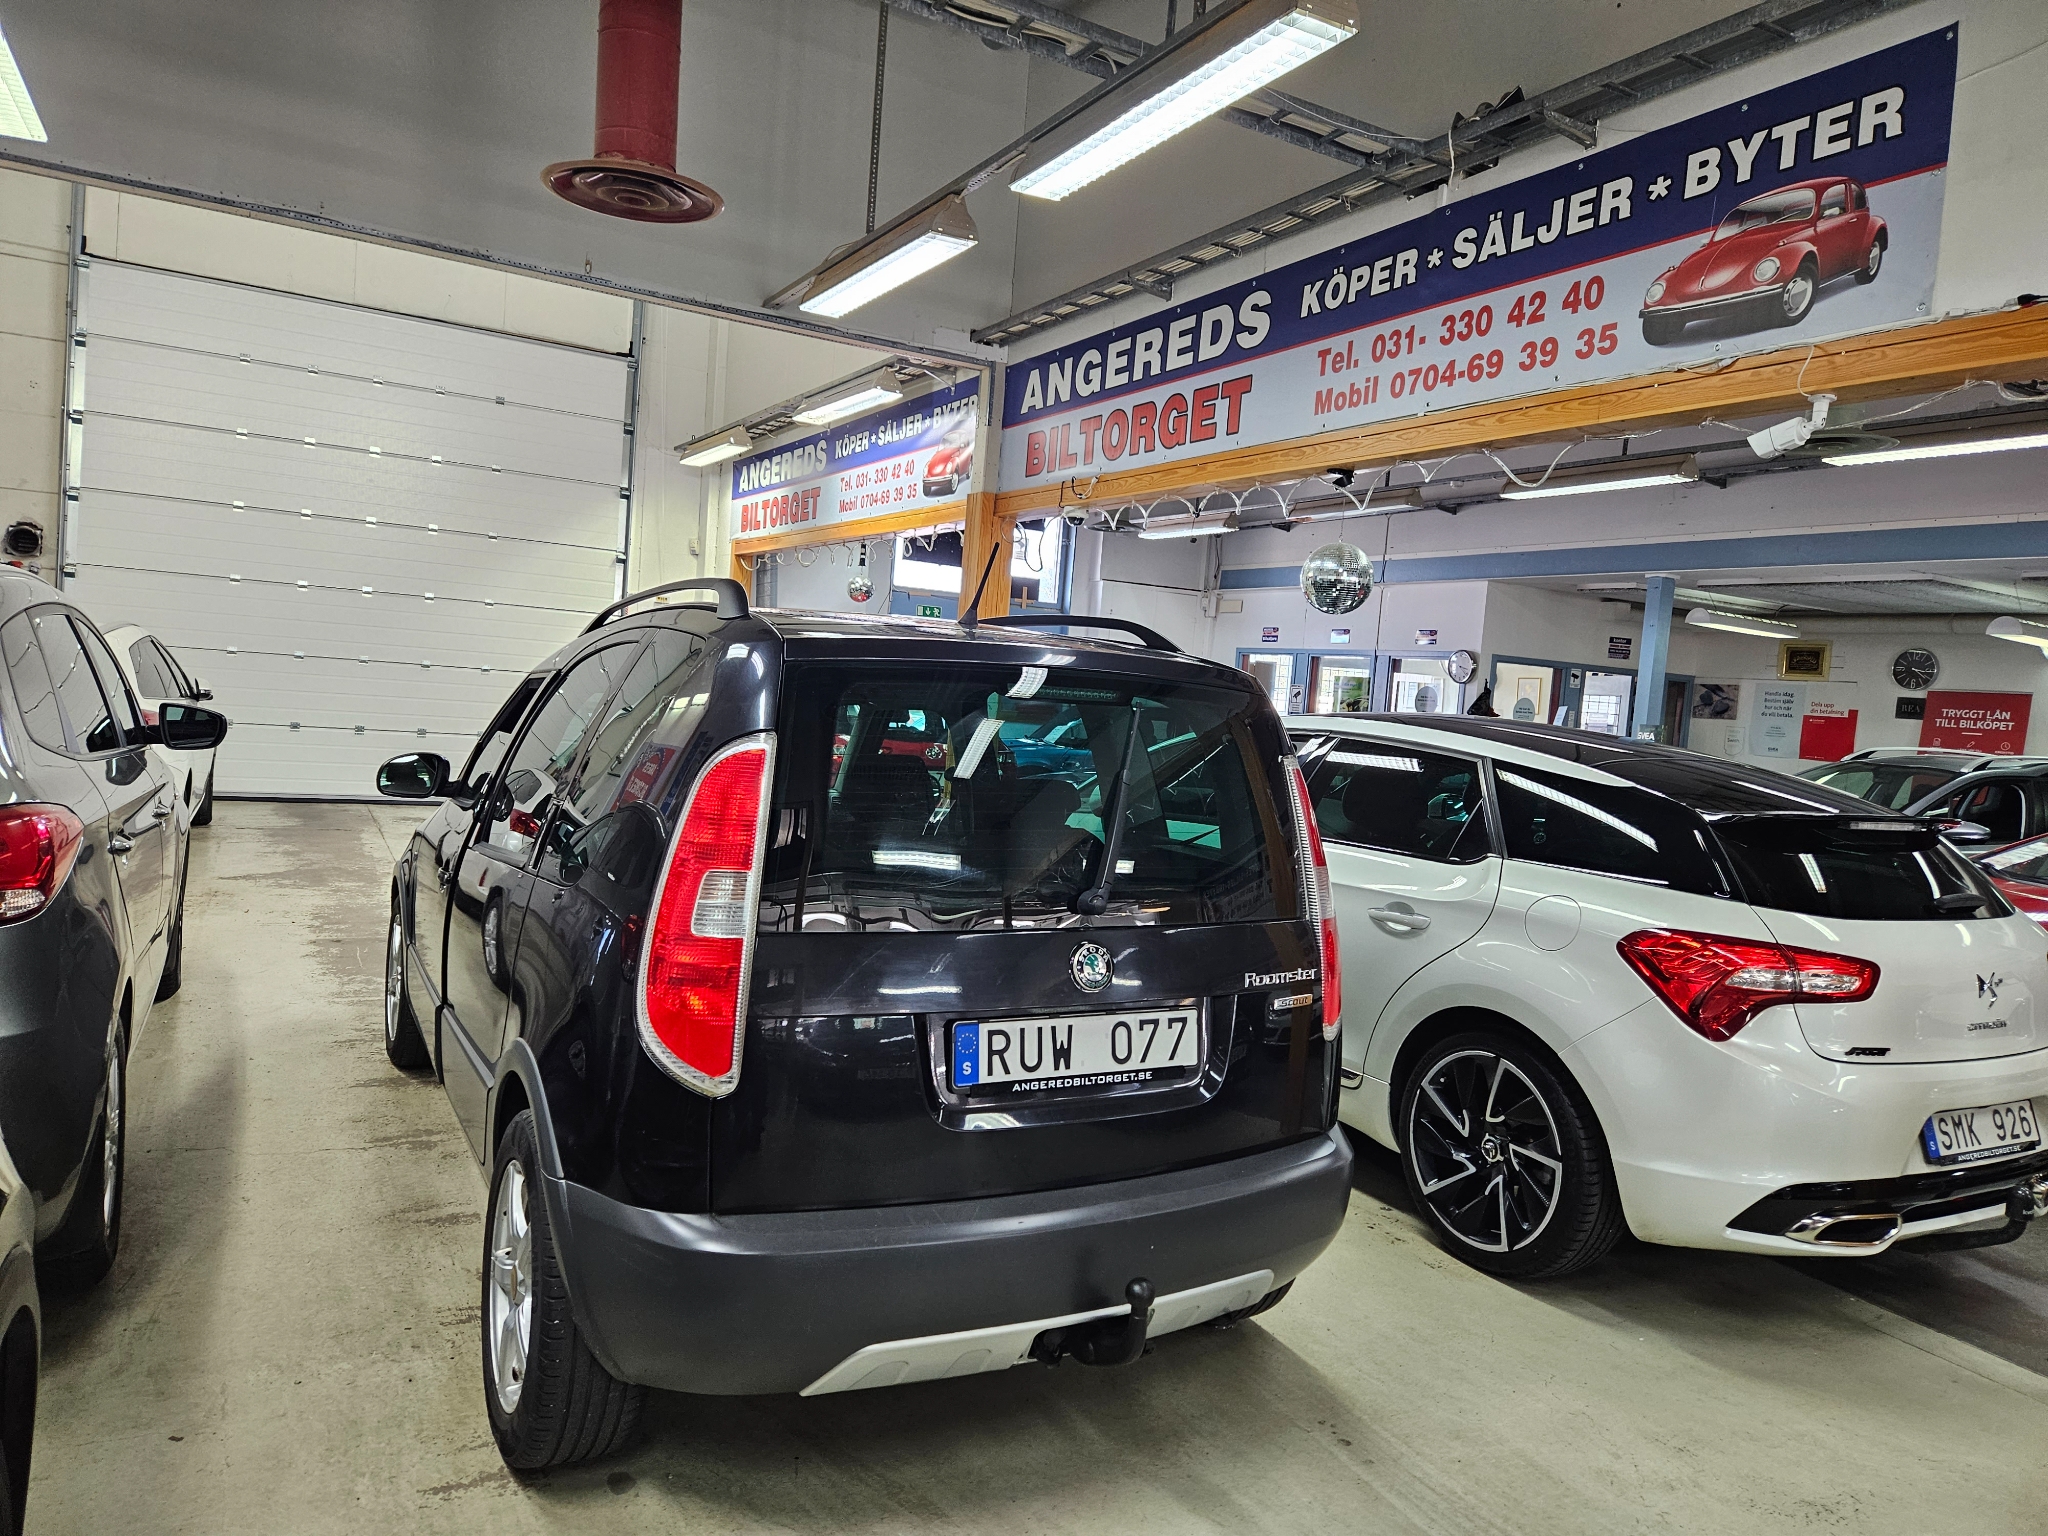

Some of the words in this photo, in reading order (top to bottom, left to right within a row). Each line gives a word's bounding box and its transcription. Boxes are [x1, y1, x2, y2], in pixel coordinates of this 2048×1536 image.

[1299, 247, 1420, 320] KÖPER
[1451, 175, 1635, 270] SÄLJER
[1682, 85, 1906, 201] BYTER
[1317, 340, 1360, 377] Tel.
[1371, 324, 1427, 364] 031-
[1439, 304, 1494, 347] 330
[1507, 290, 1547, 329] 42
[1562, 275, 1605, 315] 40
[1019, 290, 1273, 416] ANGEREDS
[1313, 375, 1379, 416] Mobil
[1390, 348, 1504, 400] 0704-69
[1518, 336, 1559, 372] 39
[1575, 322, 1619, 360] 35
[834, 431, 870, 460] KÖPER
[877, 413, 923, 447] SÄLJER
[1024, 374, 1254, 479] BILTORGET
[738, 440, 828, 494] ANGEREDS
[840, 474, 853, 493] Tel.
[874, 467, 889, 485] 330
[891, 463, 901, 481] 42
[904, 459, 915, 477] 40
[740, 486, 822, 533] BILTORGET
[838, 496, 858, 514] Mobil
[860, 490, 890, 509] 0704-69
[893, 487, 903, 503] 39
[907, 483, 918, 499] 35
[1910, 678, 1916, 689] 6
[1935, 718, 1957, 728] TILL
[1959, 719, 2015, 731] BILKÖPET
[1941, 708, 1985, 719] TRYGGT
[1986, 709, 2011, 720] LÅN
[1244, 967, 1318, 988] Roomster
[962, 1061, 972, 1076] S
[987, 1024, 1074, 1077] RUW
[1111, 1016, 1188, 1065] 077
[1012, 1071, 1153, 1092] ANGEREDBILTORGET.SE
[1937, 1112, 1982, 1151] SMK
[1992, 1105, 2032, 1141] 926
